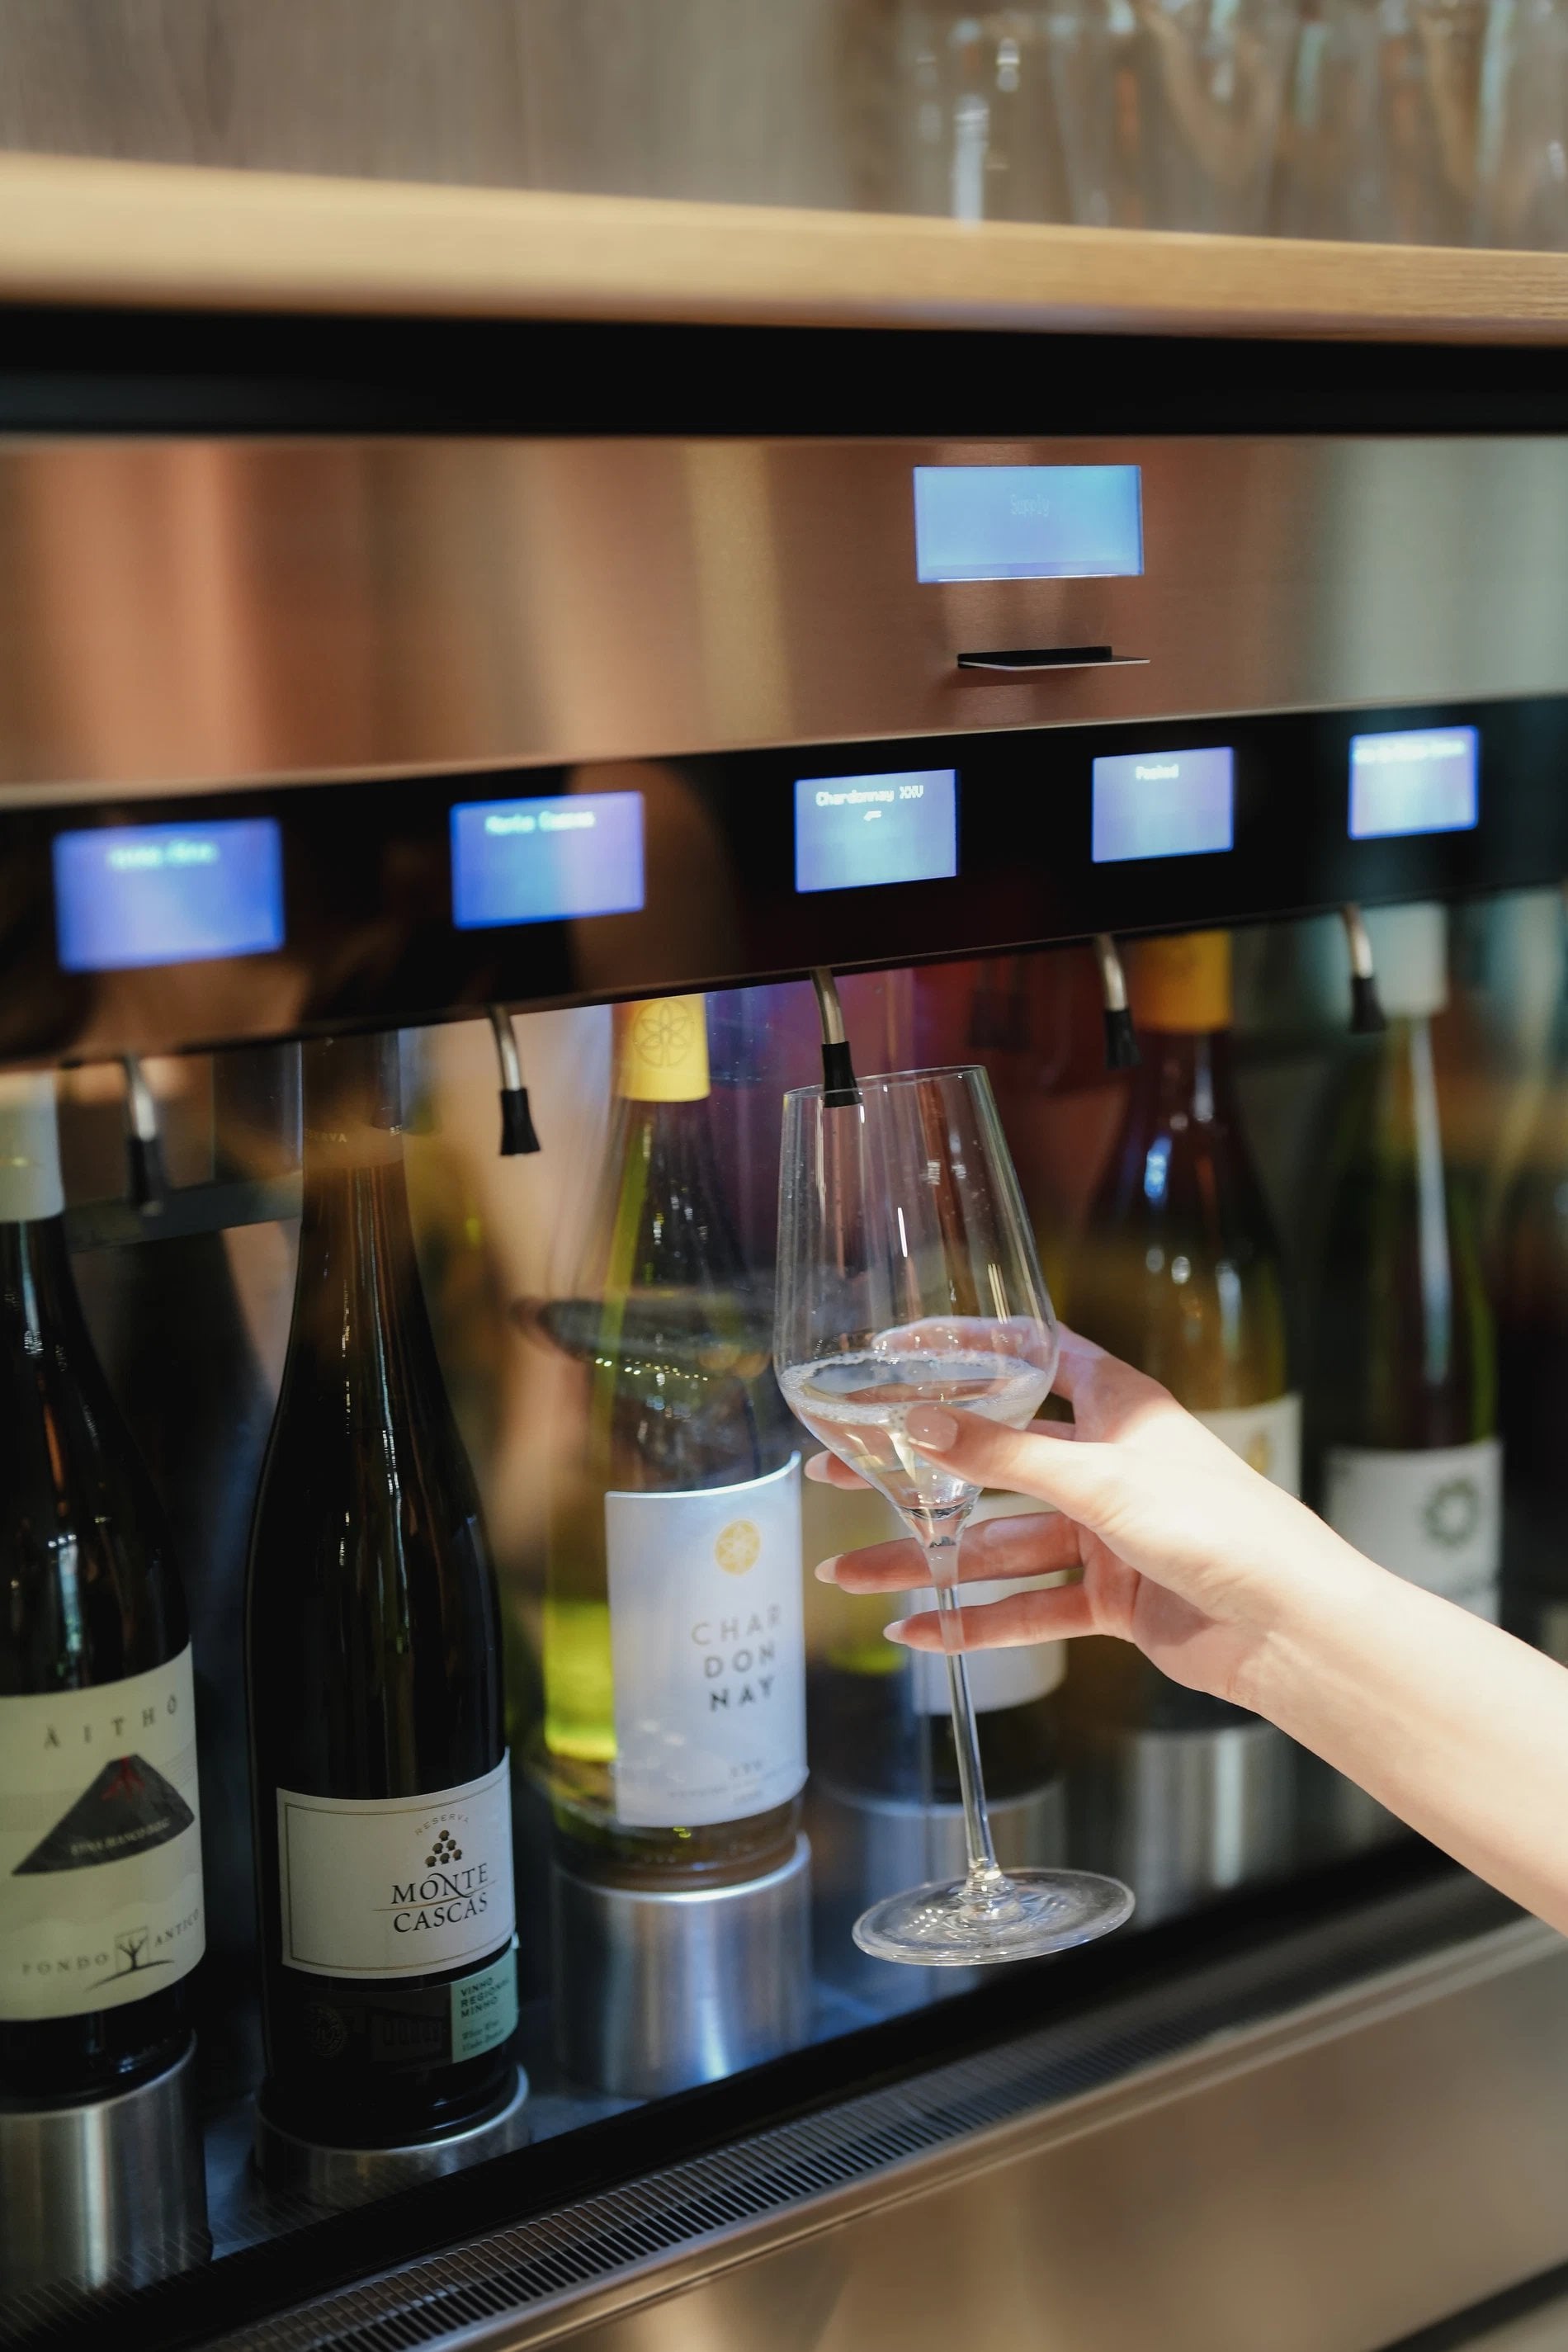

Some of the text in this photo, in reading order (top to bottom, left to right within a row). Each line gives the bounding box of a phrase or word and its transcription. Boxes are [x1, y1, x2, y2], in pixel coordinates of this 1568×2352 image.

[815, 789, 895, 807] Chardonnay
[691, 1603, 782, 1646] CHAR
[703, 1640, 776, 1679] DON
[708, 1676, 773, 1713] NAY
[413, 1813, 470, 1836] RESERVA
[390, 1862, 489, 1905] MONTE
[154, 1907, 200, 1948] ANTICO
[393, 1892, 489, 1933] CASCAS
[21, 1952, 109, 1977] FONDO
[460, 1977, 494, 1997] VINHO
[460, 1996, 498, 2019] MINHO
